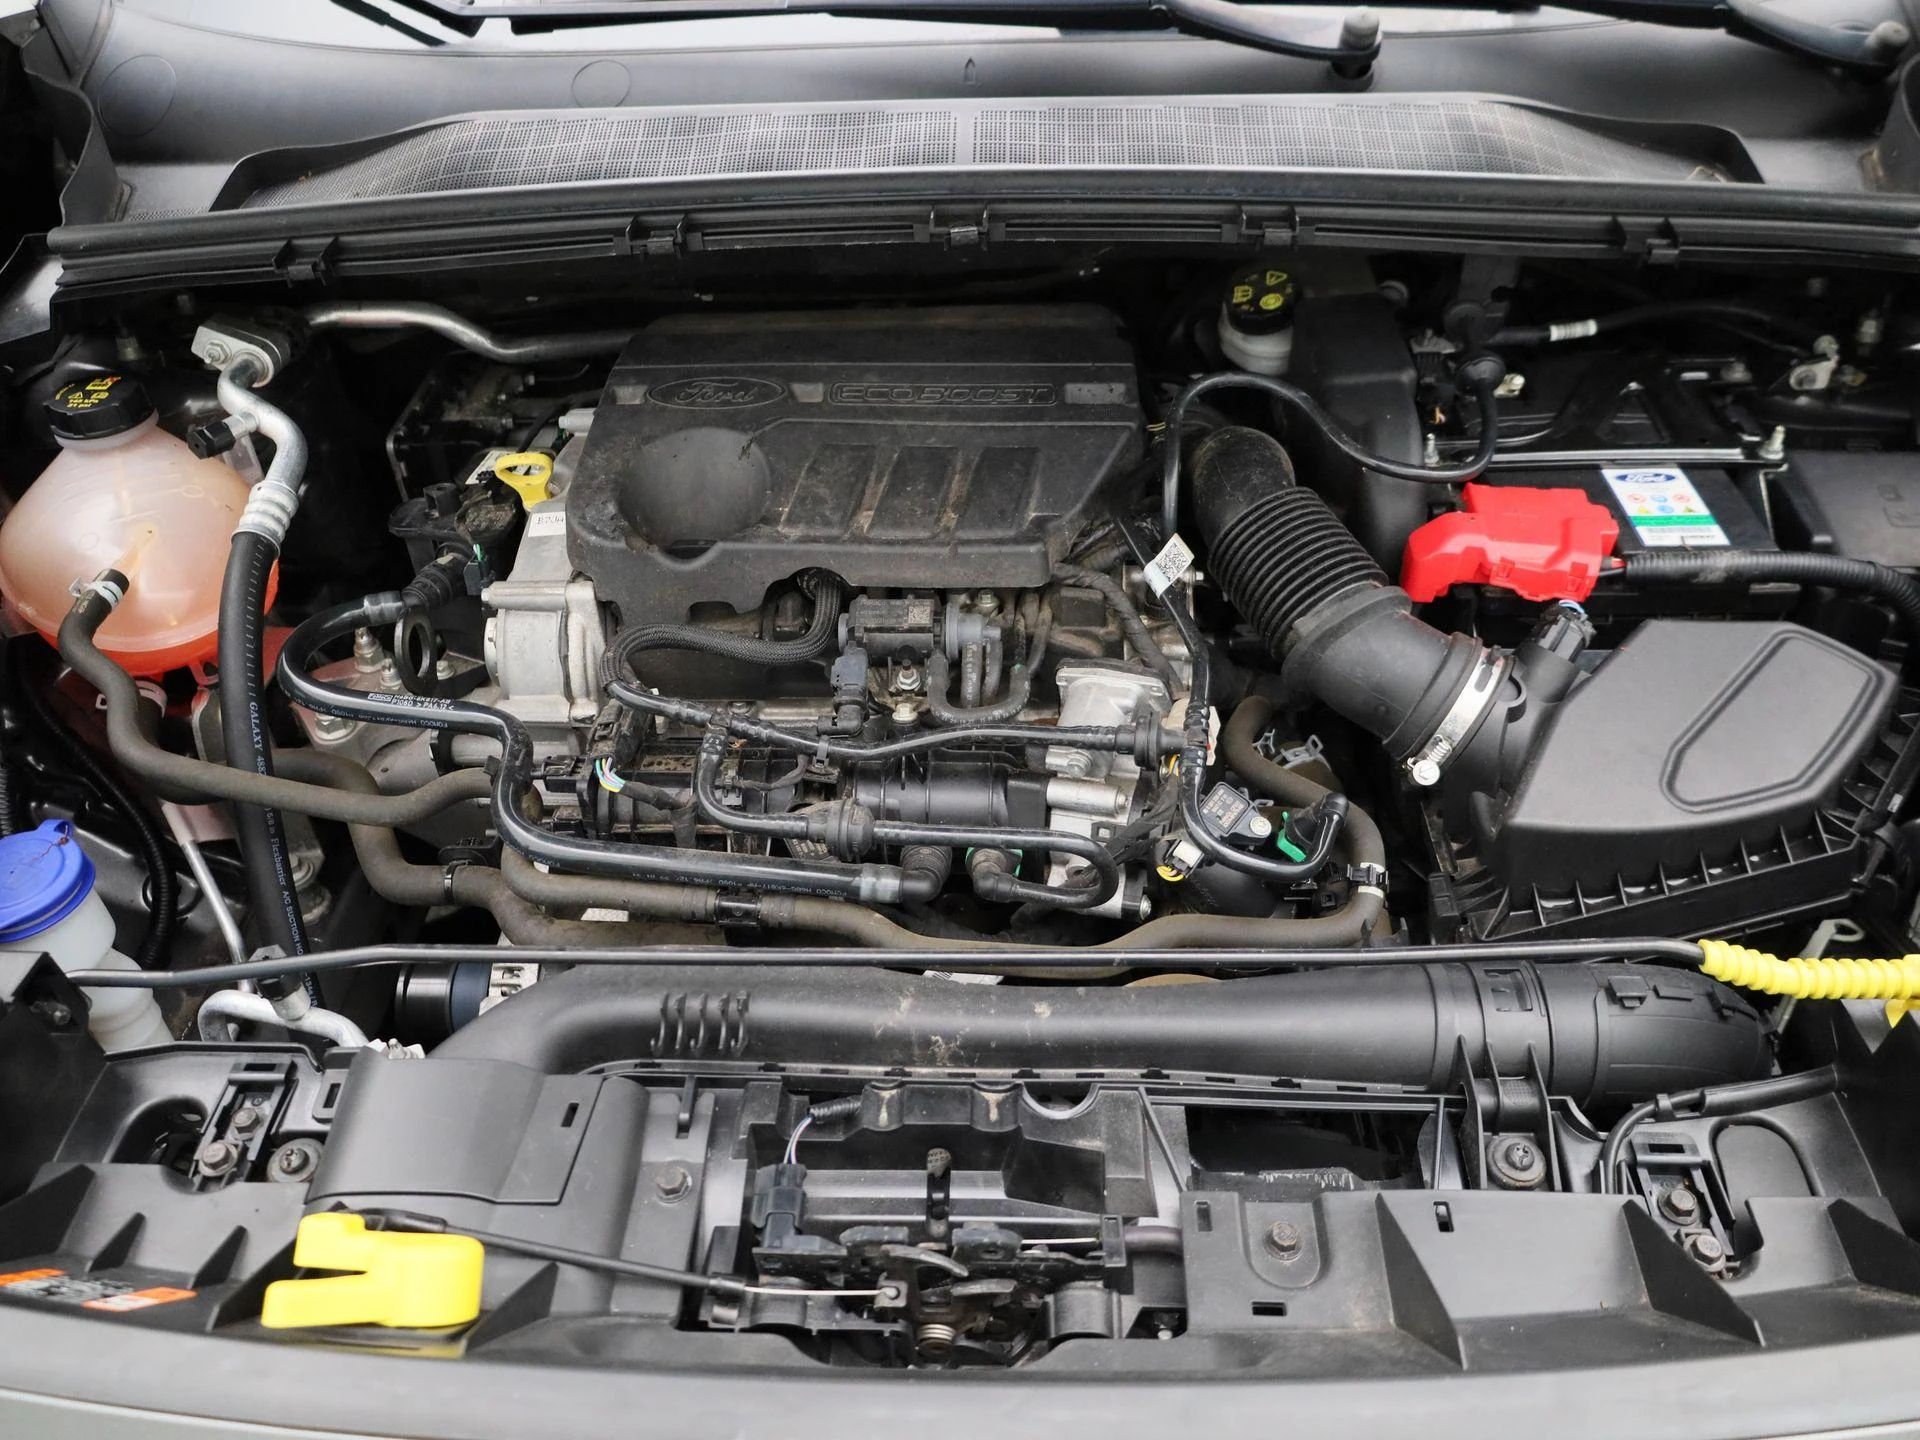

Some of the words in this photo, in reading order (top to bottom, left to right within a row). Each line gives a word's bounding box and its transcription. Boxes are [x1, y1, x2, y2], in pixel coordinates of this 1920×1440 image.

[675, 381, 757, 404] Ford
[837, 385, 1049, 404] ECOBOOST
[249, 701, 264, 751] GALAXY
[270, 837, 285, 887] Flexbarrier
[286, 906, 299, 943] SUCTION
